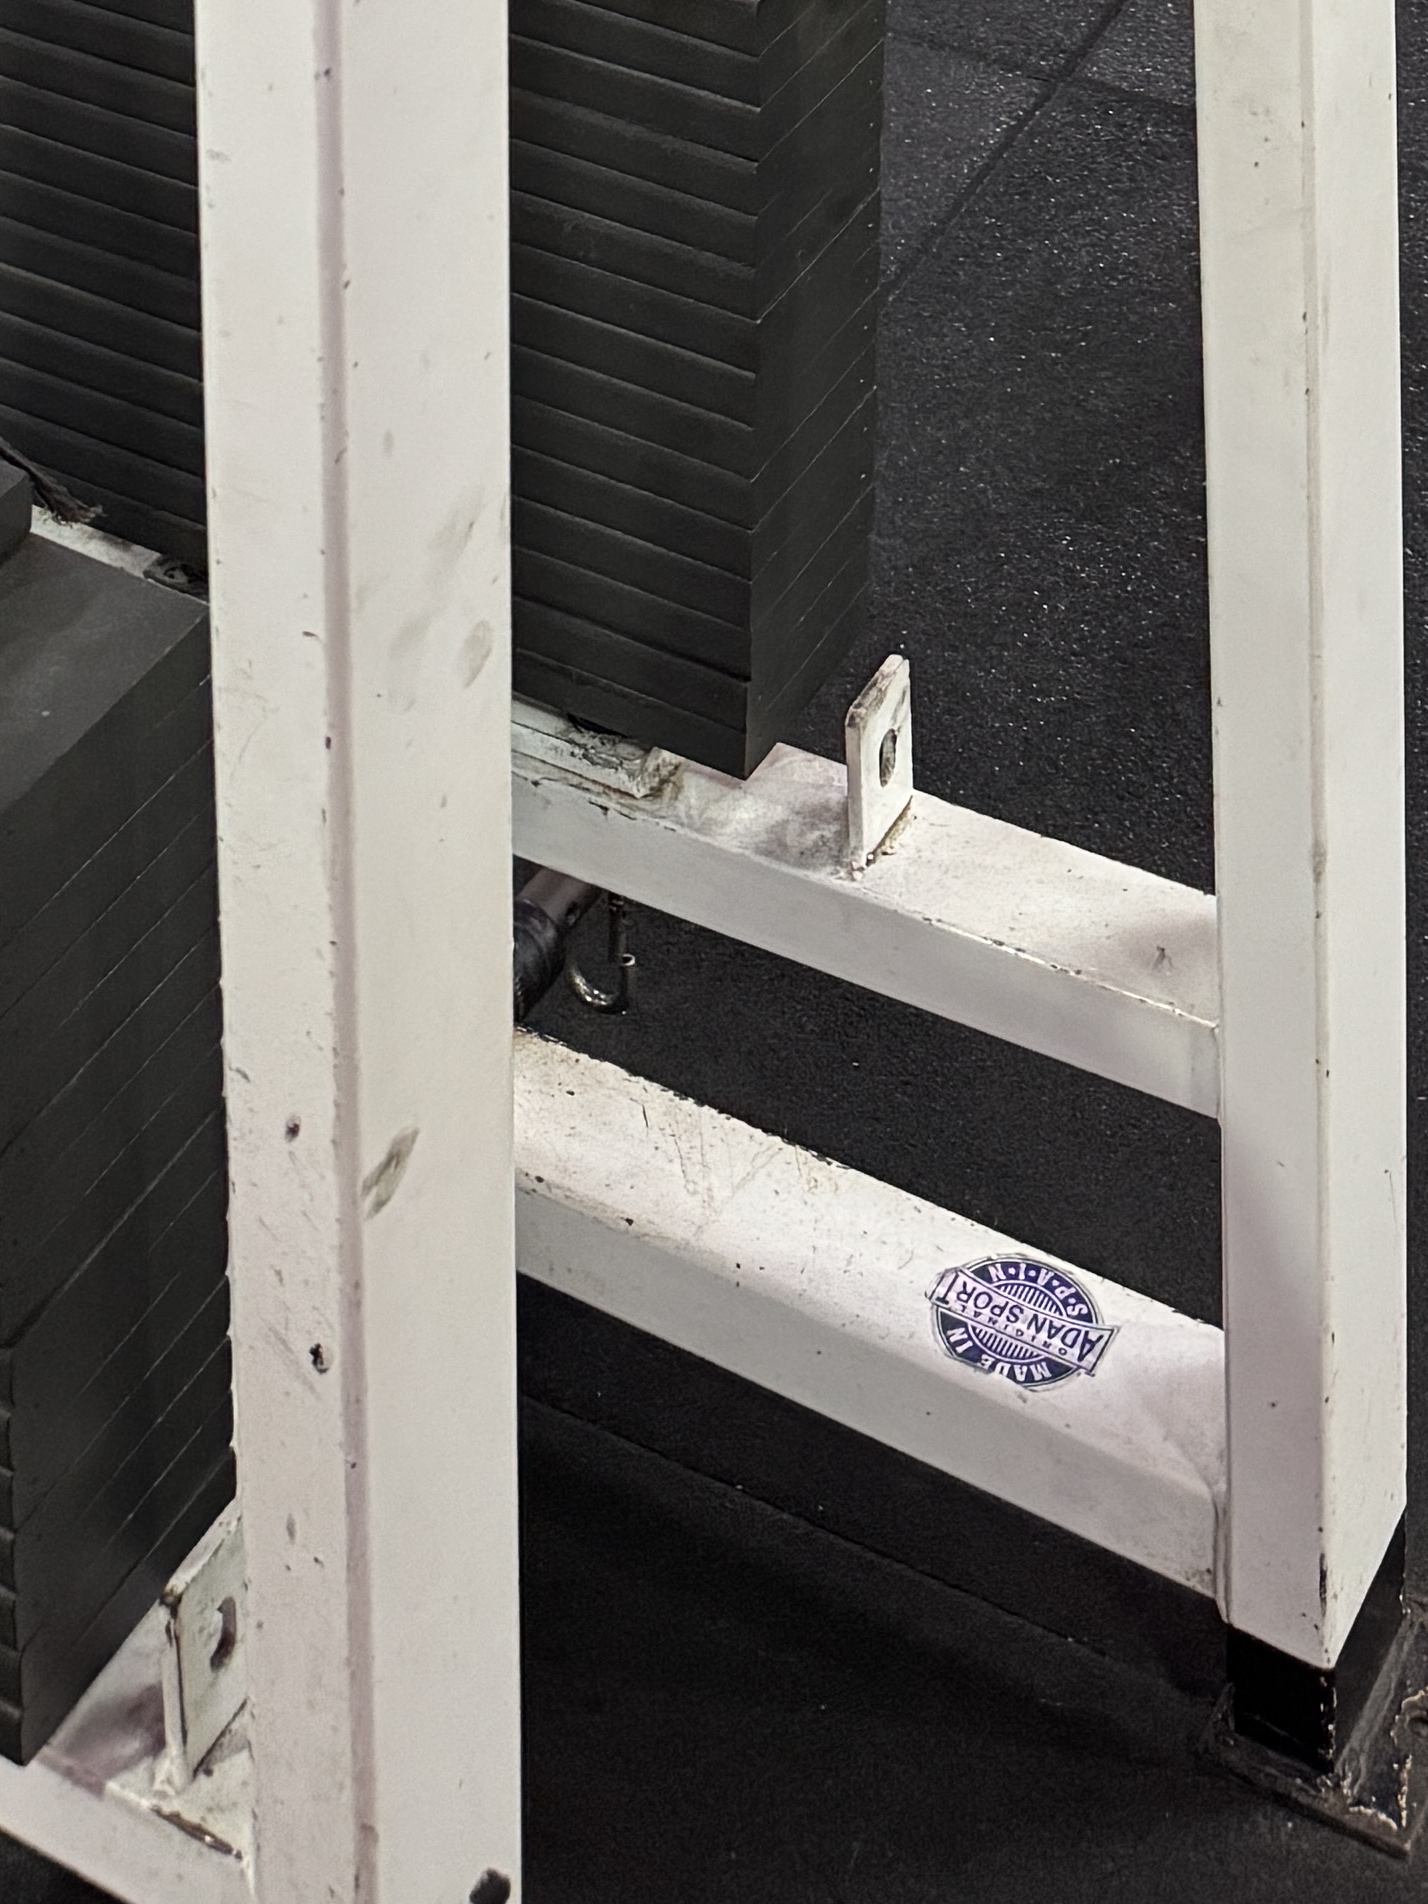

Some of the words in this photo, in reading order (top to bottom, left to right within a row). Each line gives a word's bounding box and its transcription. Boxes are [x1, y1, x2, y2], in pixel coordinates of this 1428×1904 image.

[937, 1269, 1025, 1323] SPORT
[946, 1327, 974, 1354] IN
[958, 1304, 1069, 1357] ORIGINAL
[1026, 1313, 1104, 1363] ADAN
[979, 1353, 1053, 1382] MADE
